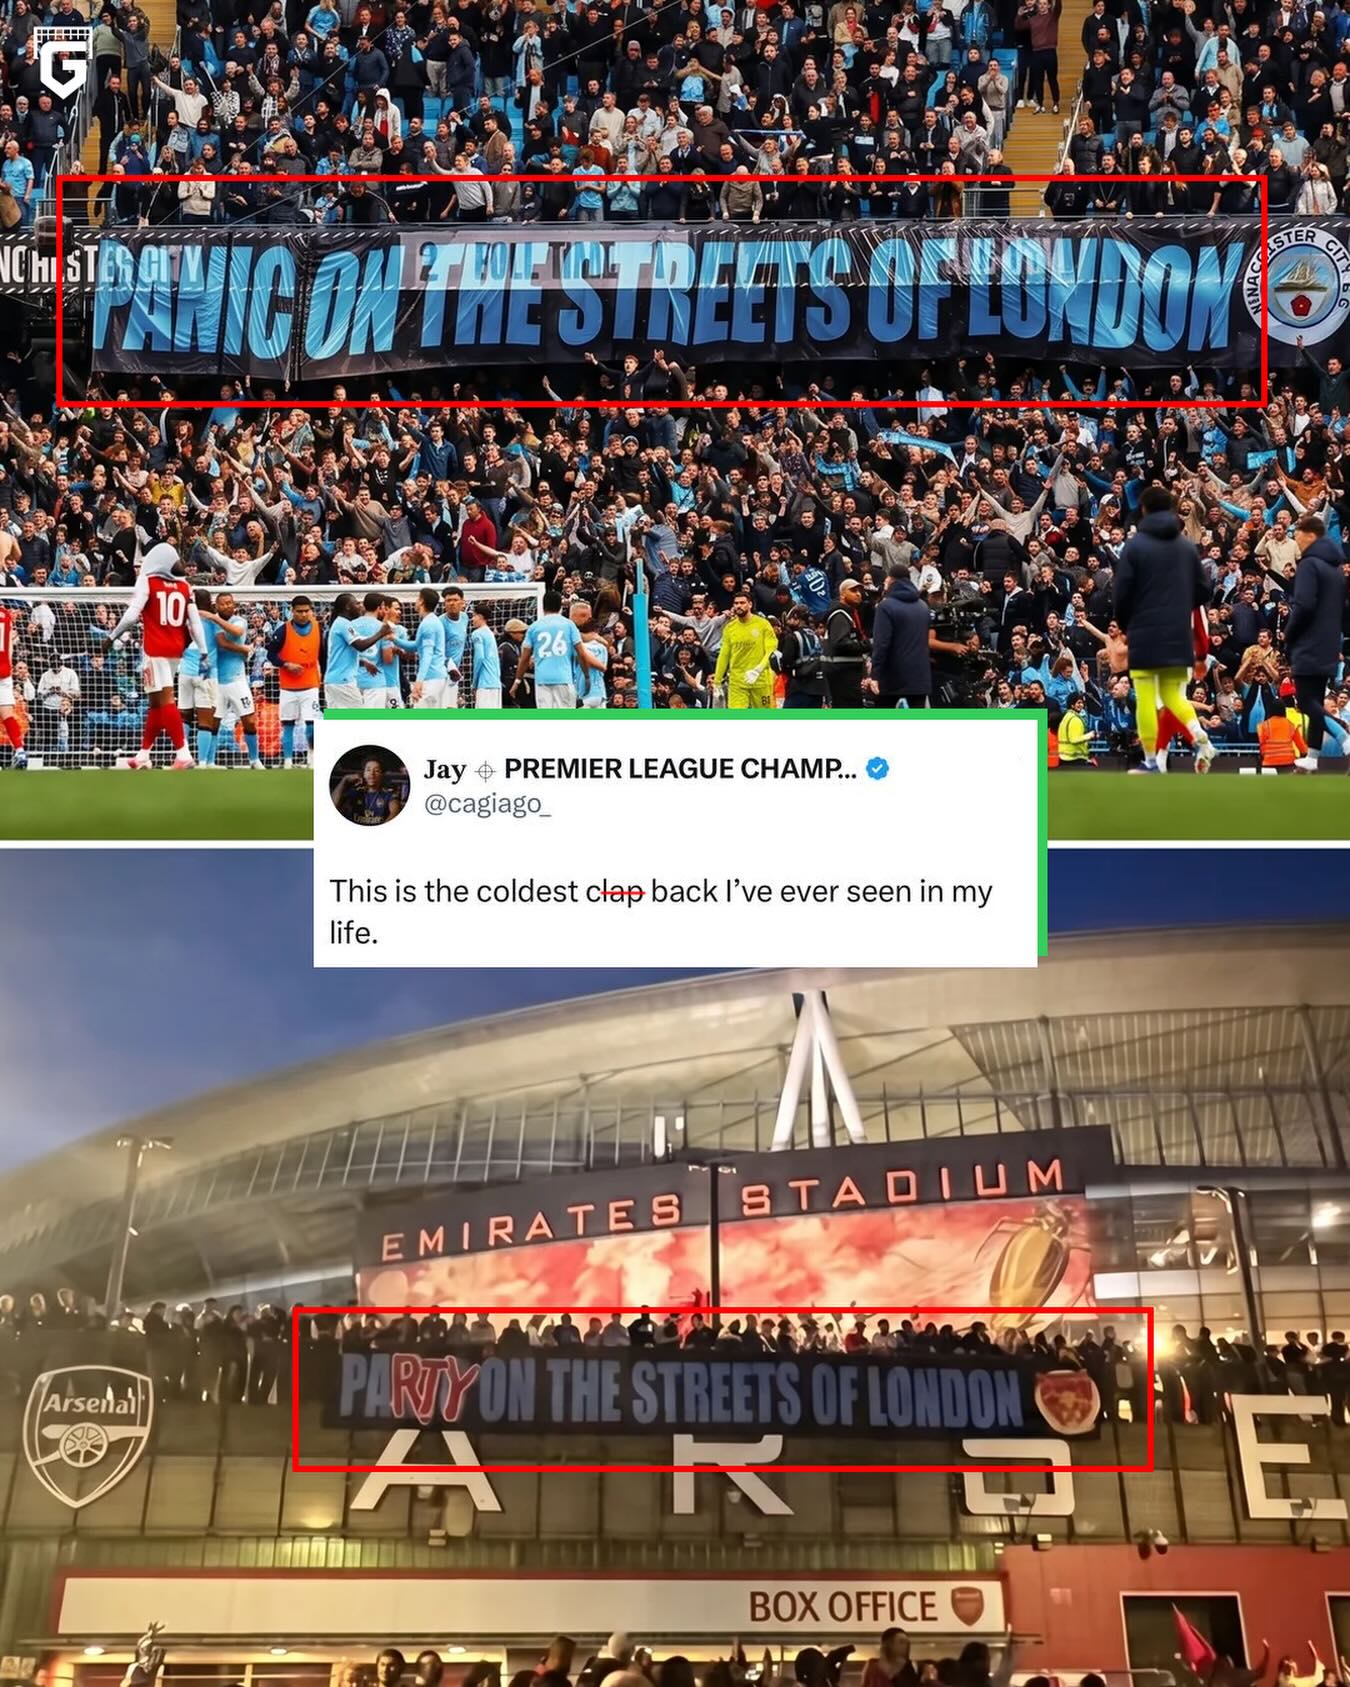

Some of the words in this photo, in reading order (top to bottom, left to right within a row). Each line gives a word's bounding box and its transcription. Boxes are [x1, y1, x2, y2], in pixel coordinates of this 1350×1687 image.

[93, 239, 297, 360] PANIC
[305, 245, 405, 359] ON
[420, 241, 553, 347] THE
[557, 238, 851, 346] STREETS
[868, 238, 956, 342] OF
[968, 237, 1245, 352] LONDON
[157, 591, 187, 627] 10
[537, 631, 568, 658] 26
[383, 1193, 682, 1262] EMIRATES
[741, 1158, 1065, 1217] STADIUM
[44, 1392, 137, 1415] Arsenal
[340, 1352, 481, 1425] PARTY
[479, 1357, 536, 1423] ON
[546, 1358, 621, 1424] THE
[632, 1361, 802, 1425] STREETS
[811, 1362, 859, 1427] OF
[868, 1364, 1025, 1429] LONDON
[750, 1590, 821, 1622] BOX
[829, 1590, 938, 1622] OFFICE
